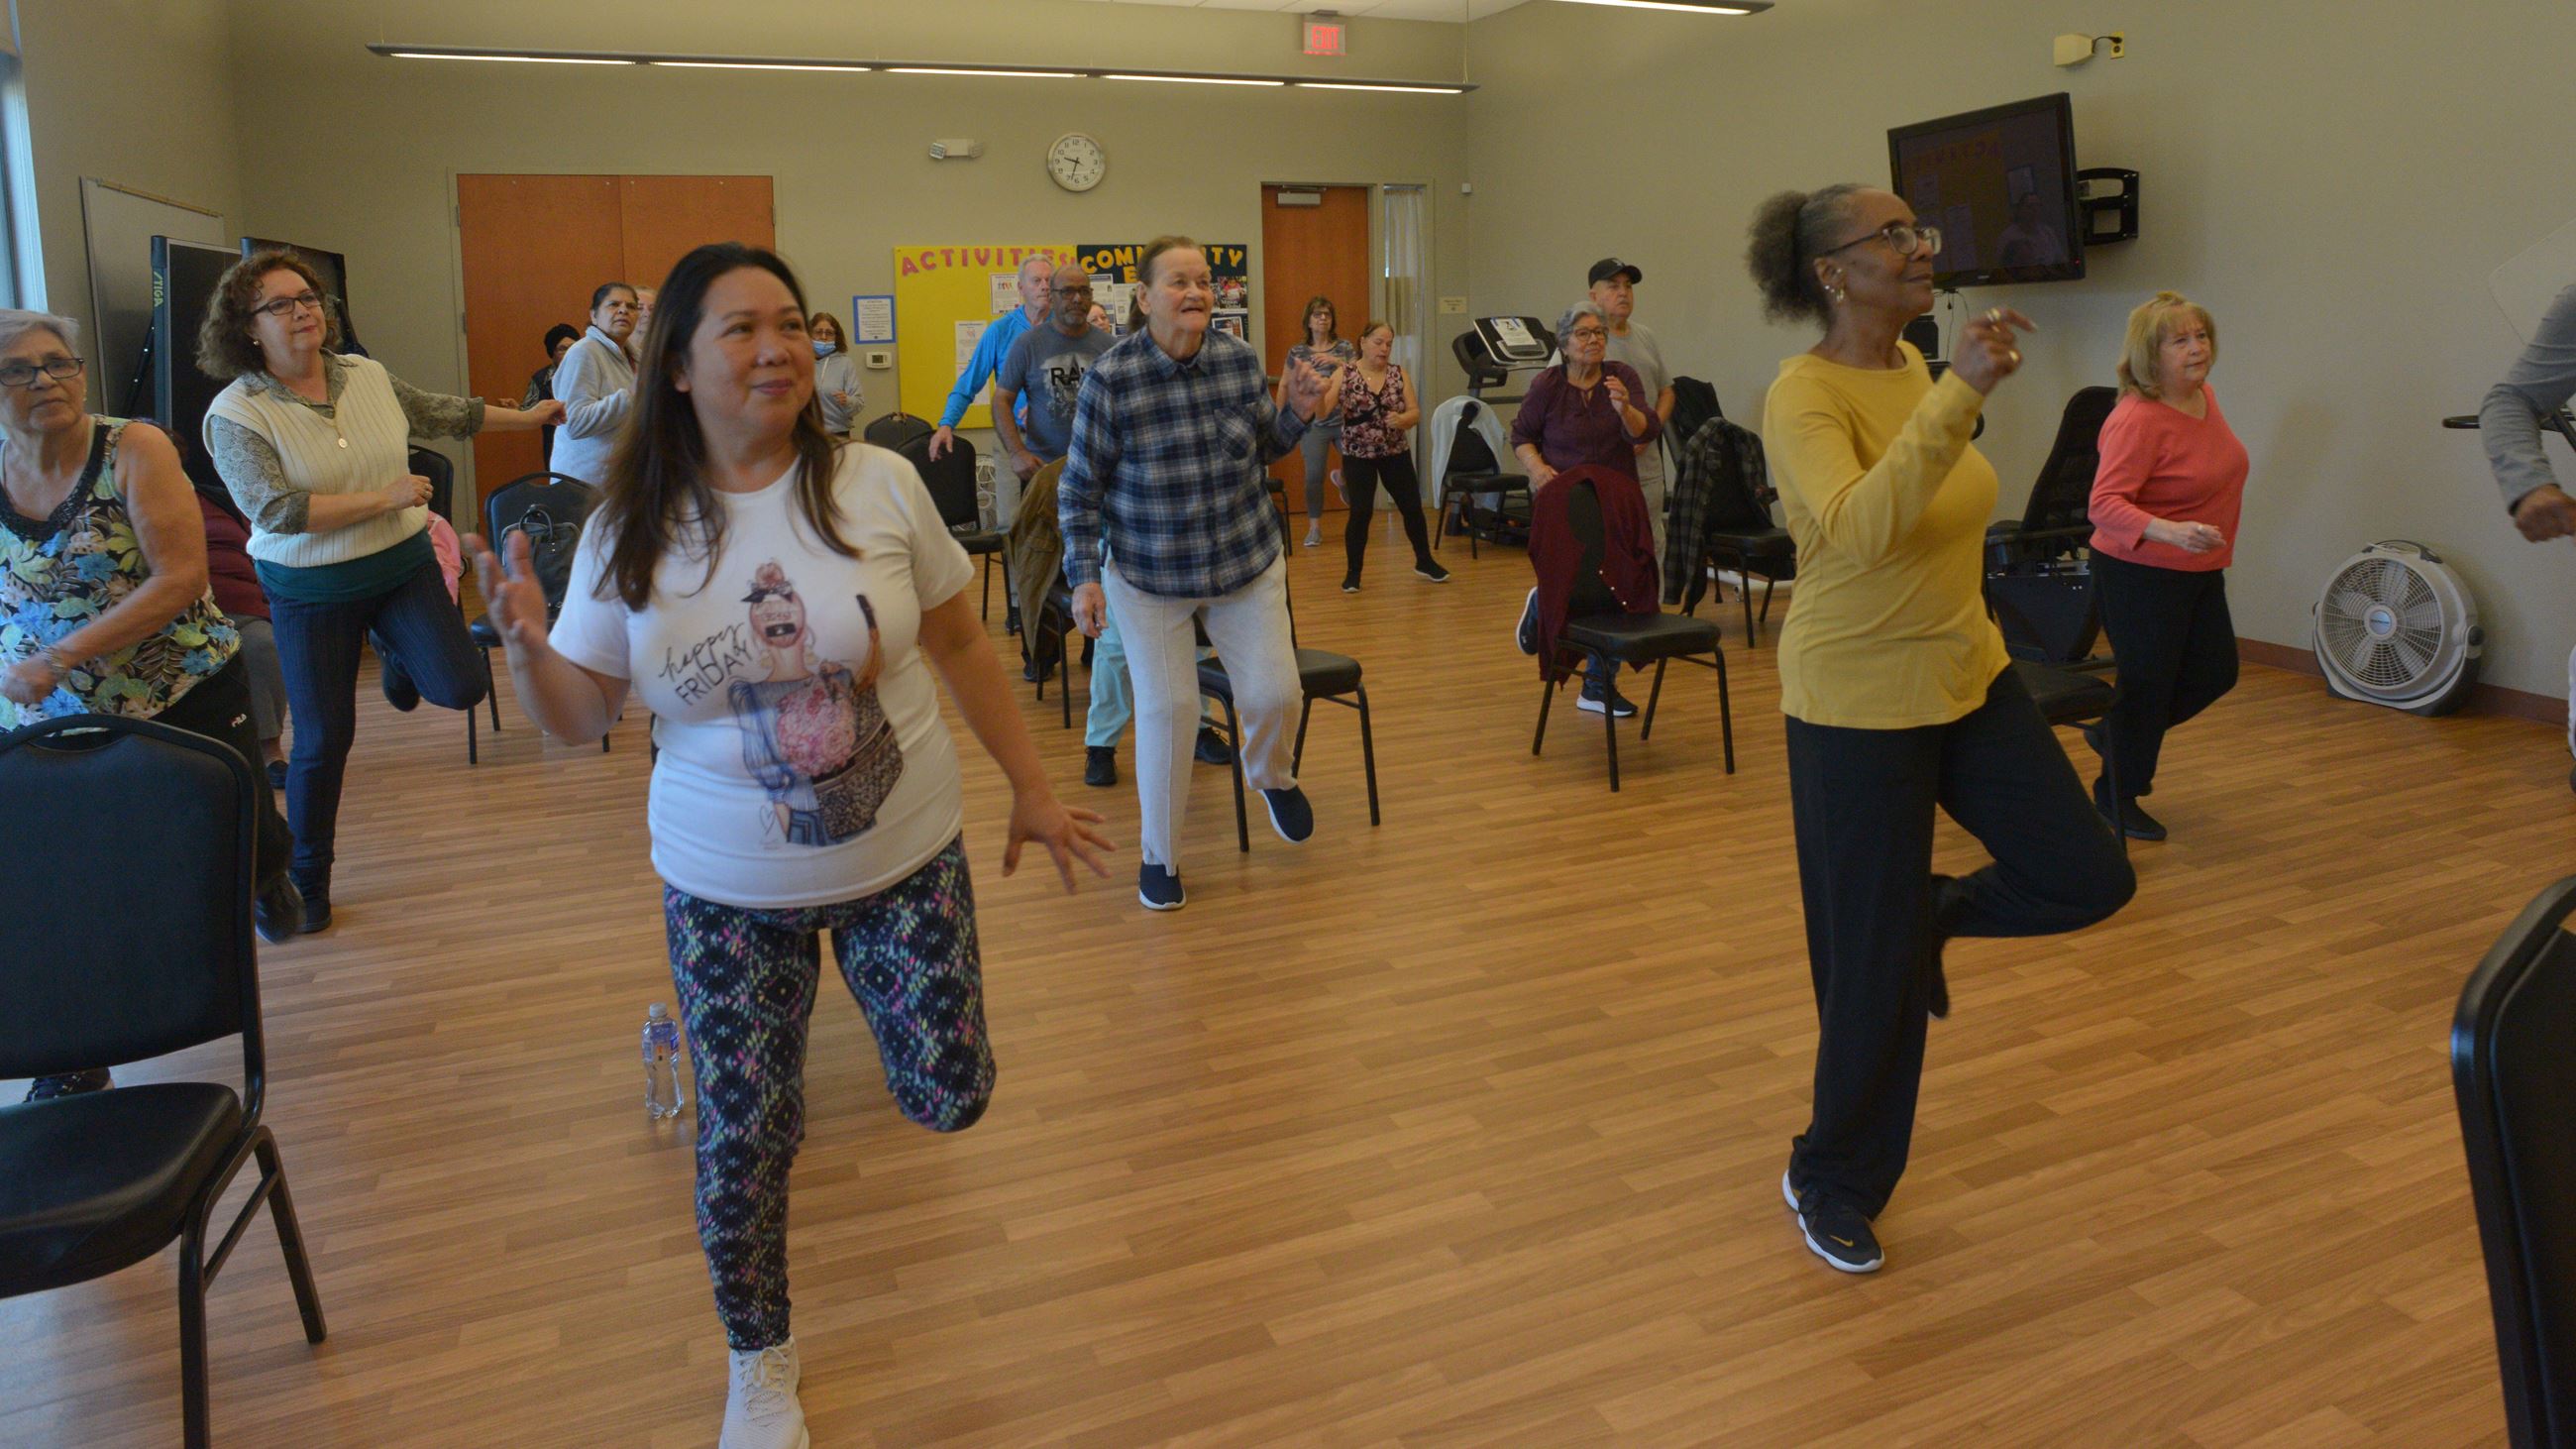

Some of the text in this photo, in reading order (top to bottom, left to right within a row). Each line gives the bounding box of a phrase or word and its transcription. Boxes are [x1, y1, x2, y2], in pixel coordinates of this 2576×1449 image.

[1312, 26, 1340, 50] EXIT
[1080, 246, 1243, 275] COMITY
[1051, 367, 1085, 386] RA
[659, 622, 745, 682] happy
[676, 639, 753, 706] FRIDAY
